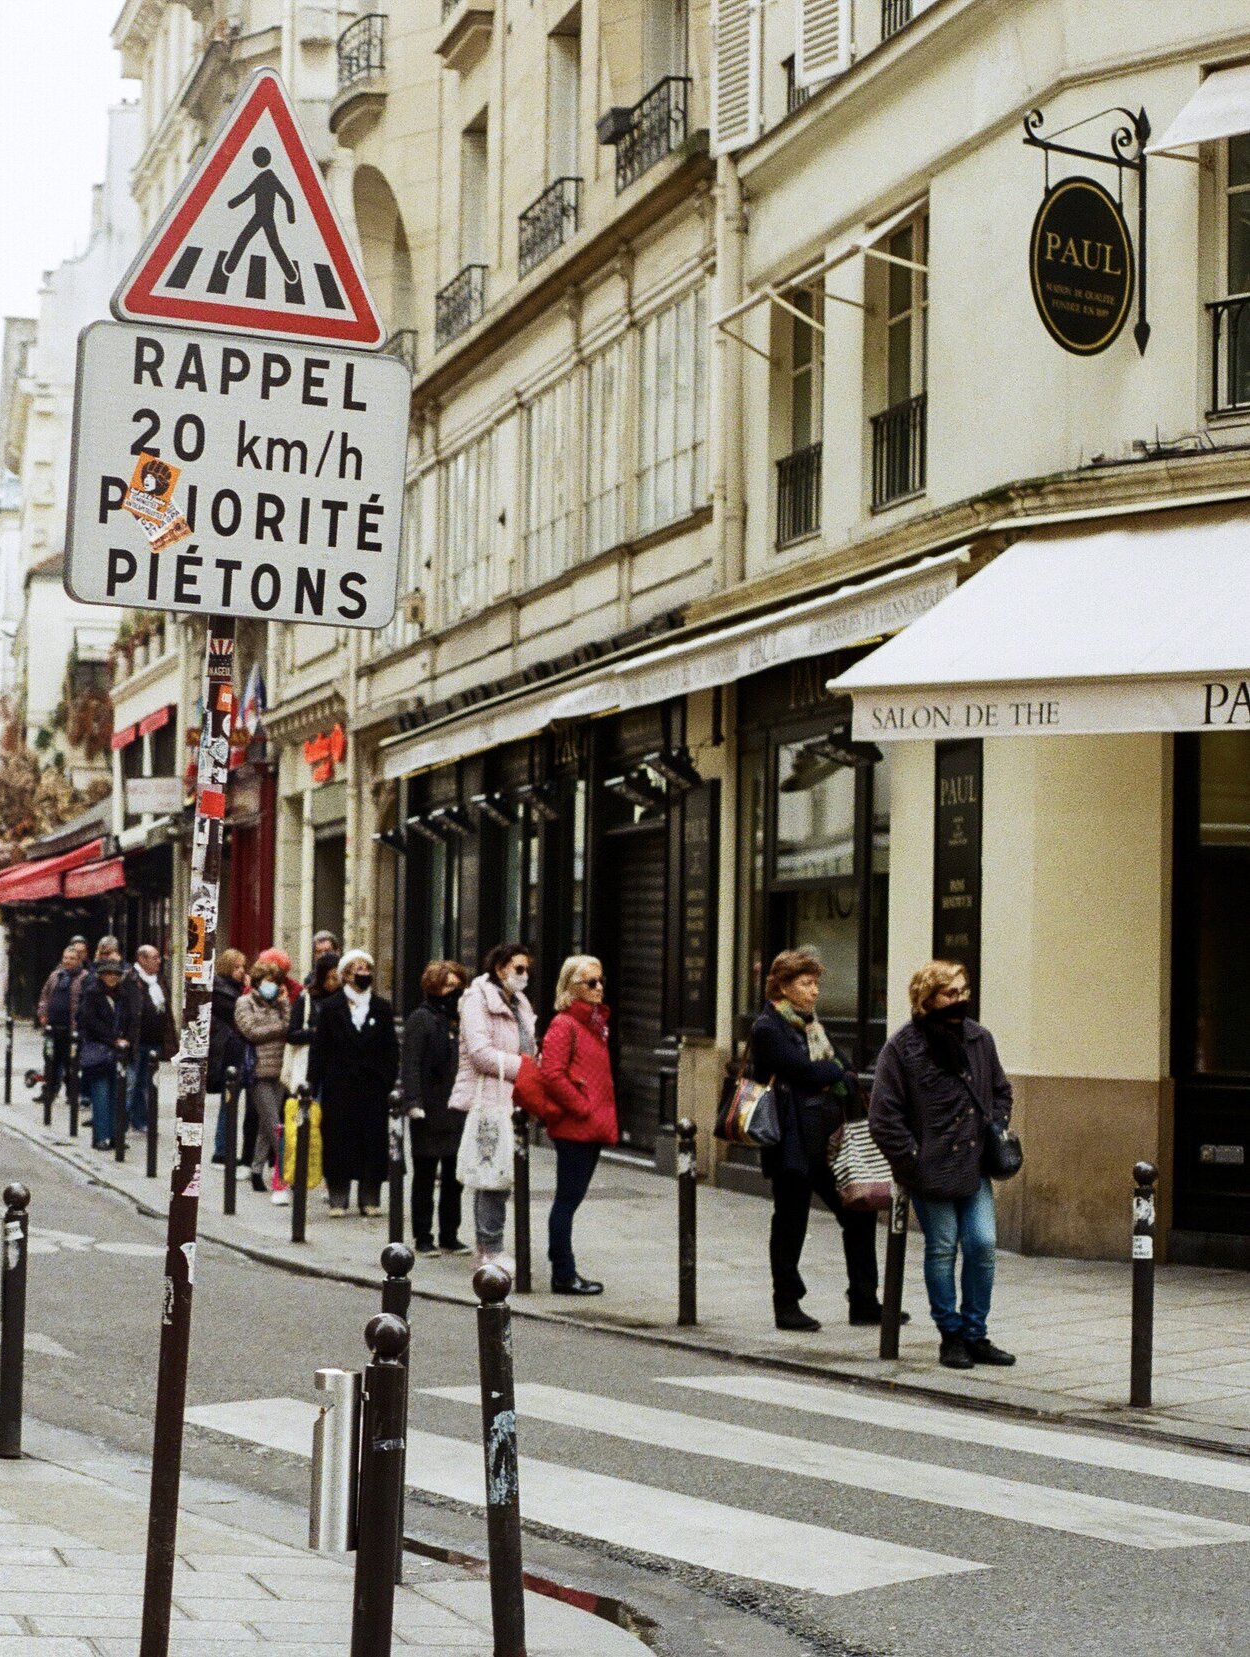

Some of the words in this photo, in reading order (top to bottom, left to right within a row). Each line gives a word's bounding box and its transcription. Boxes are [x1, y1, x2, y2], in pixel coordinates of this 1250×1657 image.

[1045, 231, 1121, 275] PAUL
[133, 336, 367, 411] RAPPEL
[130, 408, 206, 462] 20
[236, 420, 363, 481] km/h
[99, 475, 385, 553] PIORITÉ
[106, 545, 368, 620] PIÉTONS
[871, 704, 952, 731] SALON
[965, 704, 999, 728] DE
[1009, 700, 1060, 727] THE
